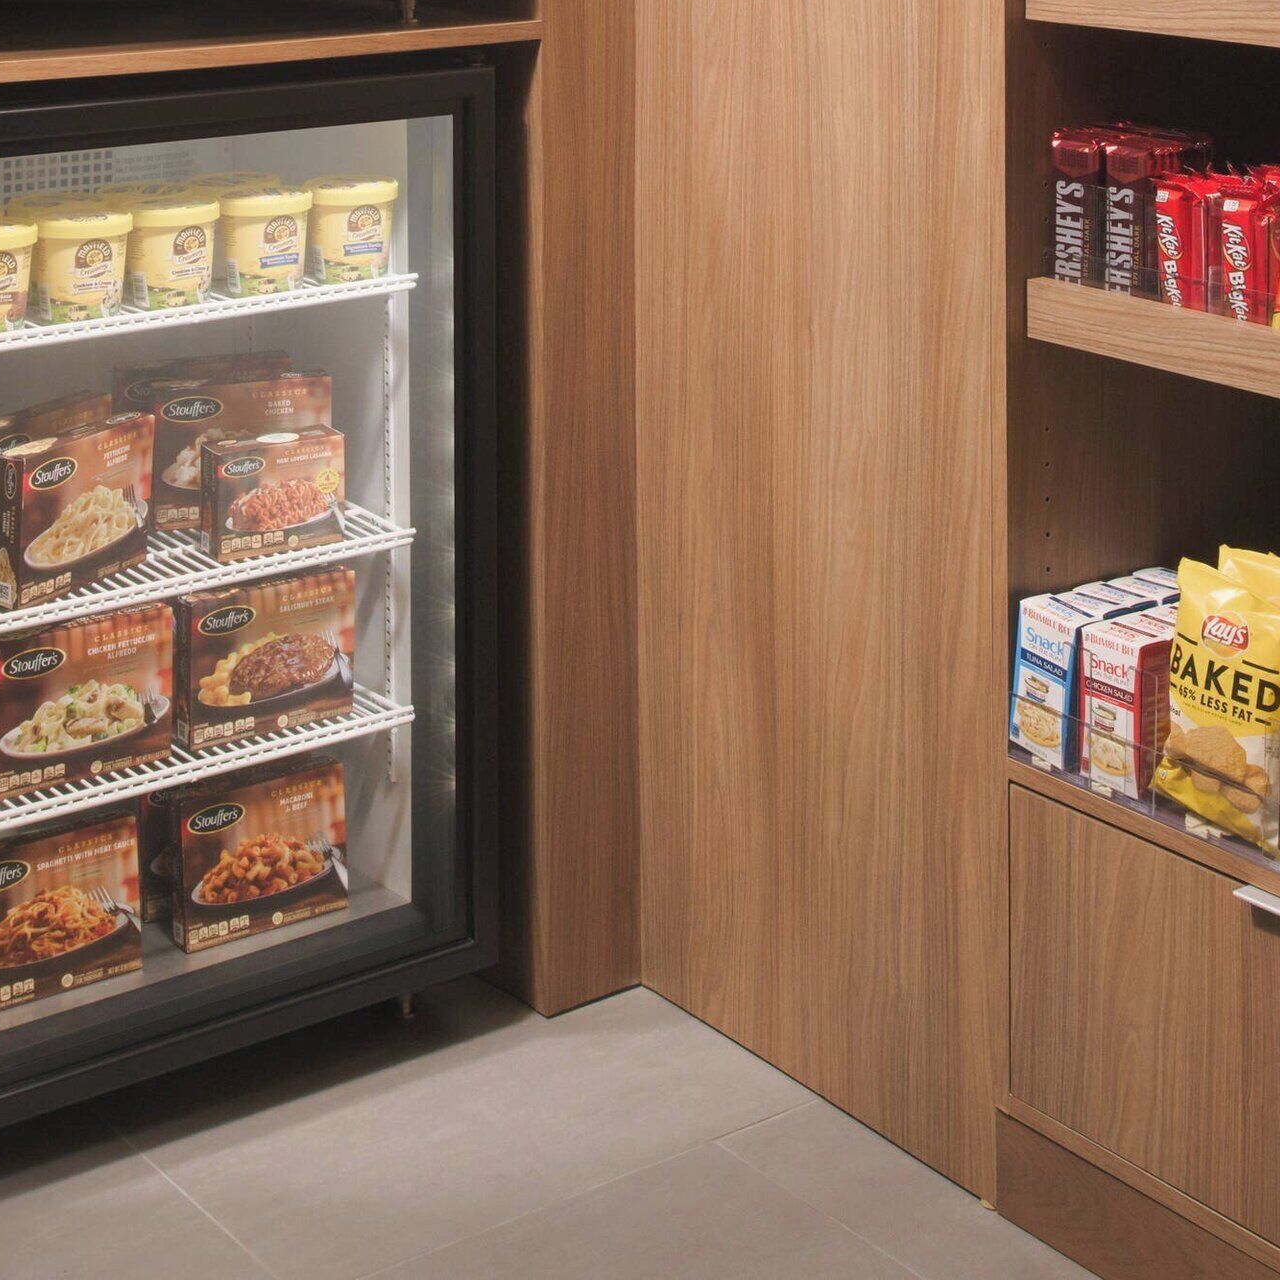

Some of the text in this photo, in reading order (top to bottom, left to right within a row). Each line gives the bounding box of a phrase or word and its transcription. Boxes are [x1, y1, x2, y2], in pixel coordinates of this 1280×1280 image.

[350, 205, 379, 222] MAYFIELD
[267, 216, 295, 234] MAYFIELD
[177, 227, 205, 246] MAYFIELD
[78, 239, 110, 258] MAYFIELD
[169, 400, 217, 418] Stouffer's
[34, 461, 73, 485] Stouffer's
[228, 460, 261, 474] Stouffer's
[204, 610, 249, 631] Stouffer's
[1205, 615, 1249, 646] Lay's
[1026, 626, 1065, 656] Snack
[9, 652, 58, 674] Stouffer's
[1026, 652, 1063, 677] TUNA SALAD
[1091, 653, 1129, 679] Snack
[1085, 679, 1133, 704] CHICKEN SALAD
[1178, 683, 1254, 723] 65% LESS FAT
[194, 806, 238, 829] Stouffer's
